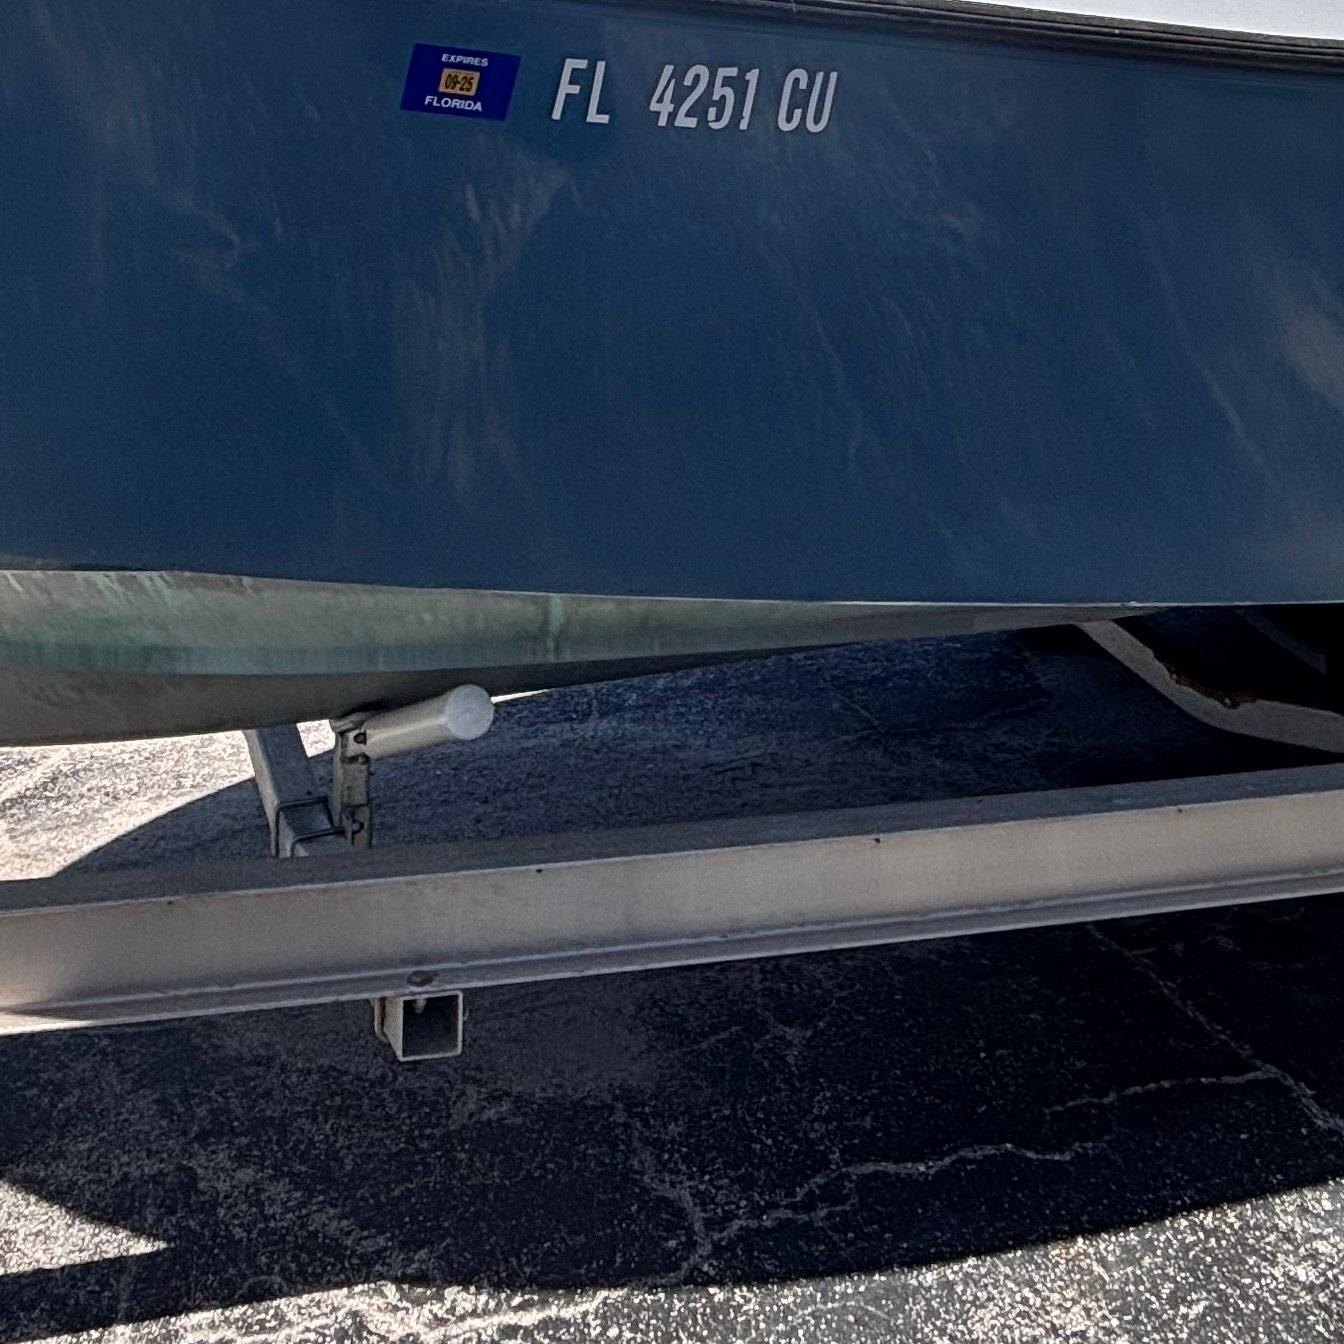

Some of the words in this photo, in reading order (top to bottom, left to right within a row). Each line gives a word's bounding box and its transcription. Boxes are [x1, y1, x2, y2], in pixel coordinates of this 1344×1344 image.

[441, 53, 489, 68] EXPIRES
[424, 95, 483, 113] FLORIDA
[551, 58, 610, 125] FL
[648, 64, 760, 131] 4251
[777, 67, 839, 134] CU
